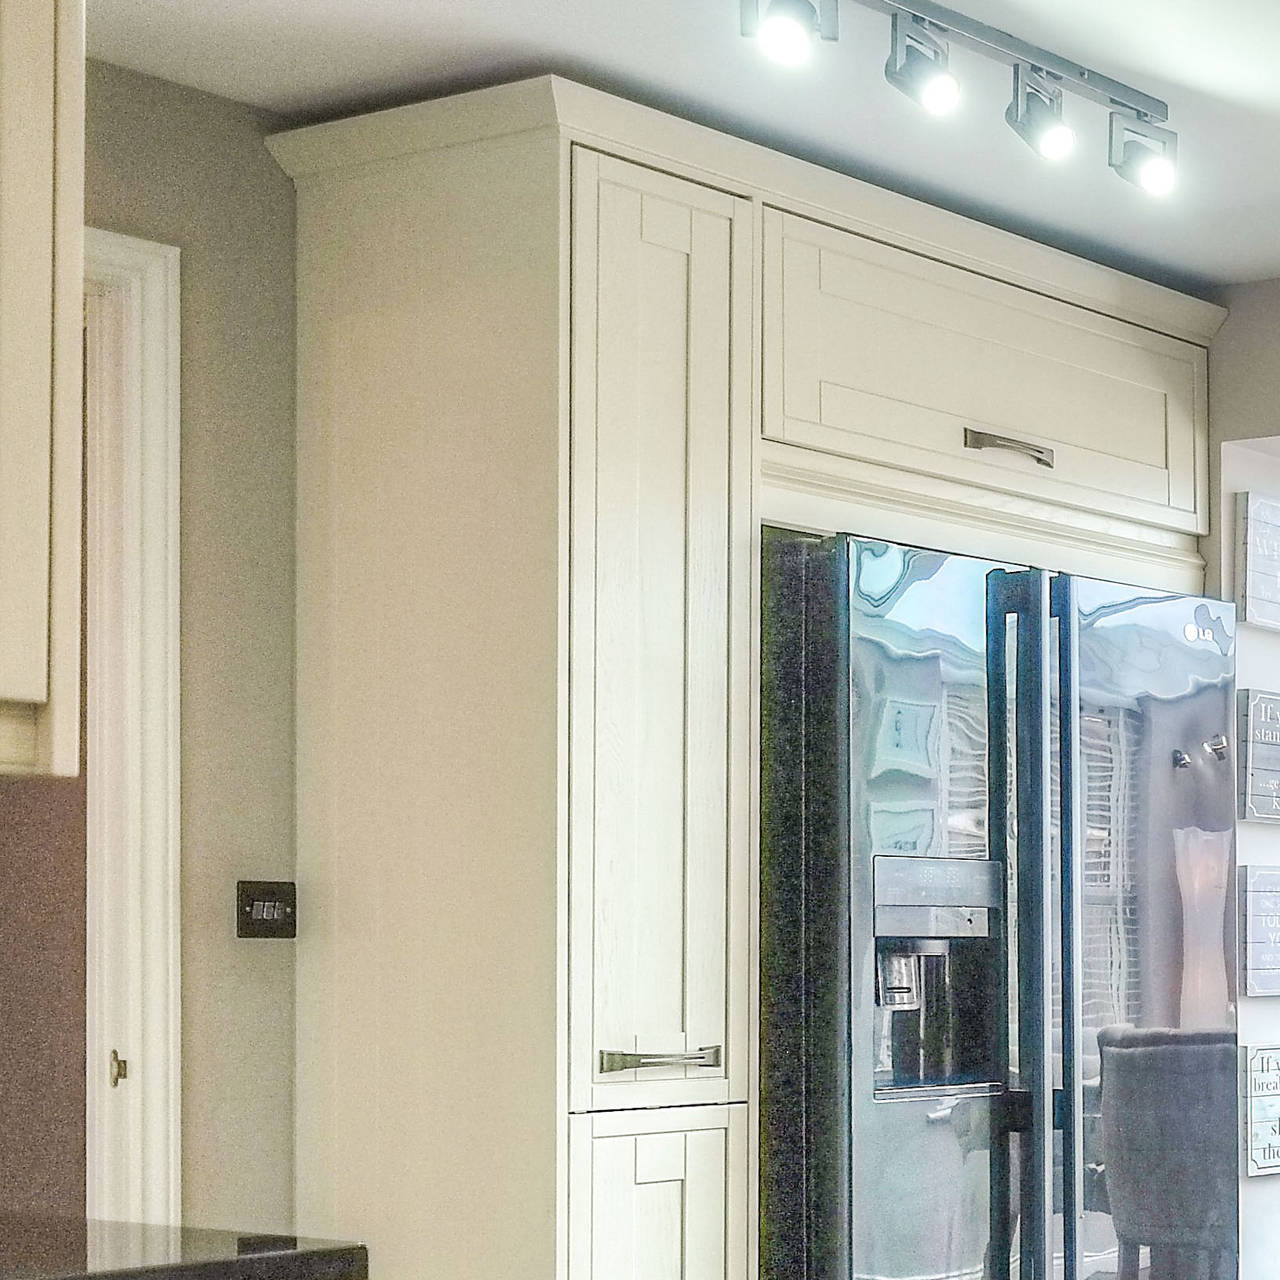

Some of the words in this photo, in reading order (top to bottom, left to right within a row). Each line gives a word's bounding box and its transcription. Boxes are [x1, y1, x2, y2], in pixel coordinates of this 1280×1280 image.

[1198, 627, 1214, 641] LG
[1260, 703, 1274, 722] If
[1261, 1056, 1272, 1073] If
